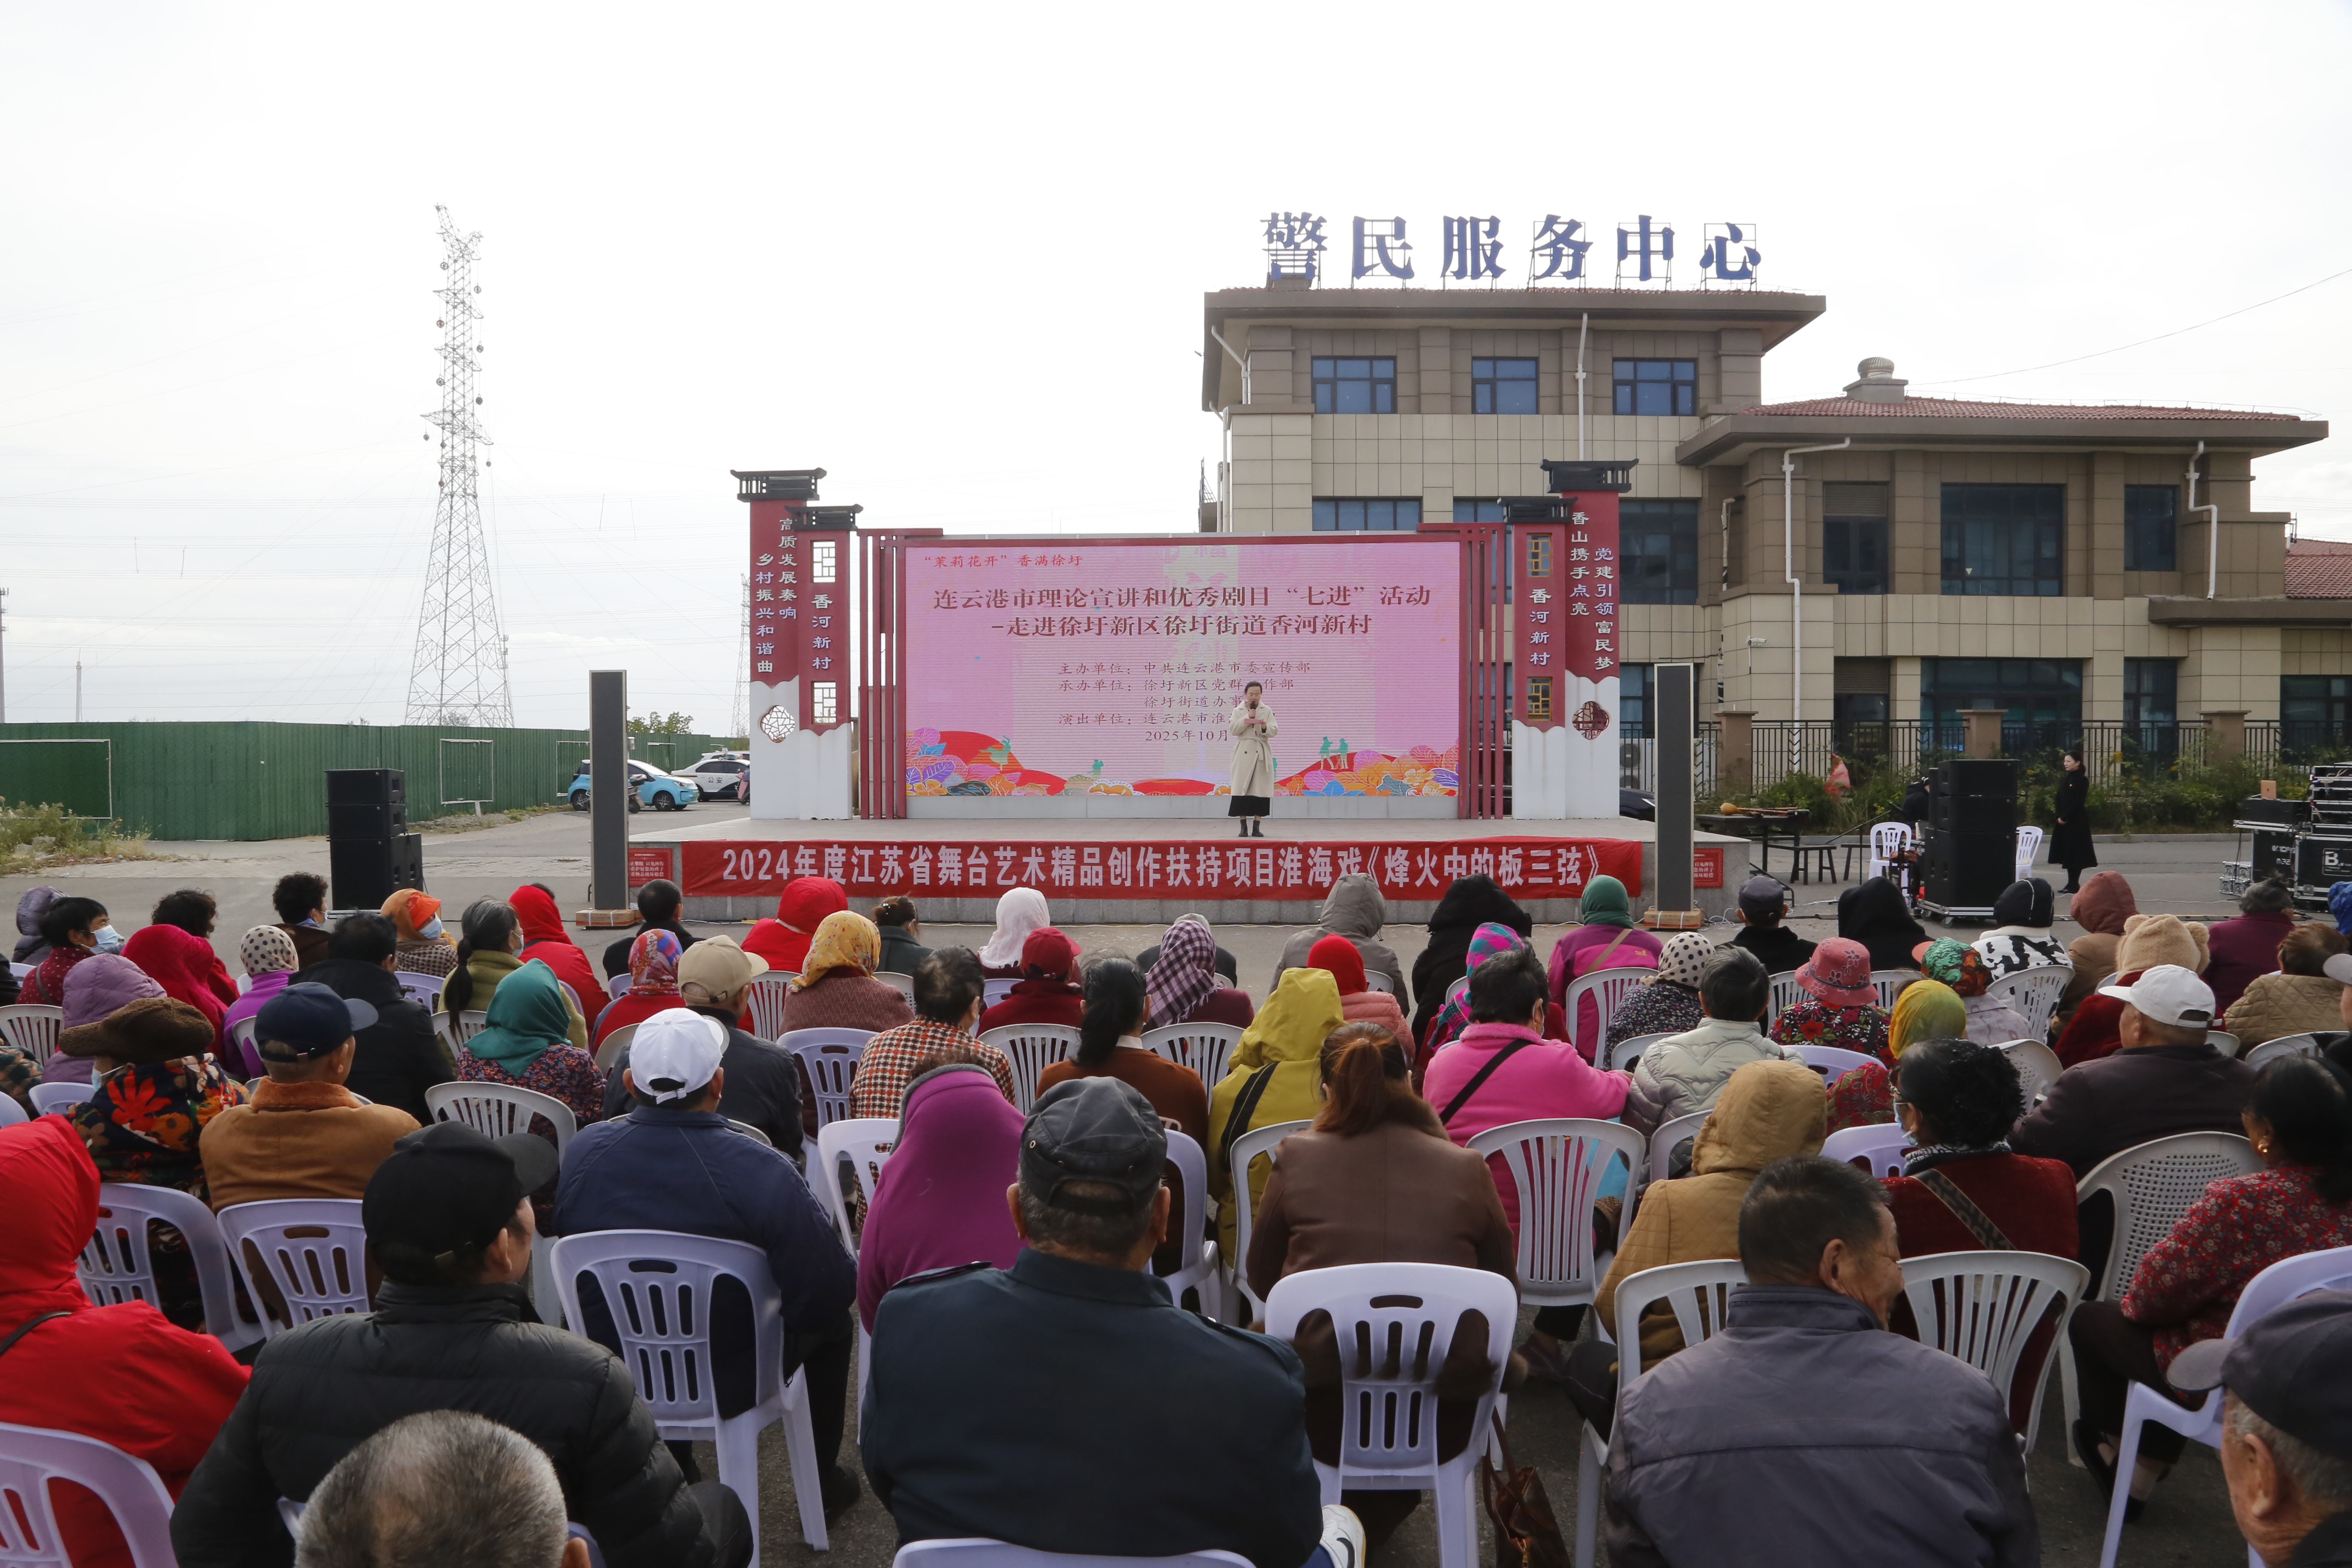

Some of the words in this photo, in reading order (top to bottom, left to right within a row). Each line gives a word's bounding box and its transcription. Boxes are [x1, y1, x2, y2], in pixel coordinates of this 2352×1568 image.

[1260, 211, 1761, 282] 警民服务中心
[778, 518, 798, 620] 高质发展奏响
[1570, 511, 1590, 616] 香山携手点亮
[756, 553, 775, 673] 乡村振兴和谐曲
[812, 594, 833, 670] 香河新村
[1529, 588, 1552, 666] 香河新村
[1594, 548, 1614, 671] 党建引领富民梦
[1059, 678, 1294, 692] 承办单位：徐圩新区党群作部
[1145, 730, 1228, 742] 2025年10月
